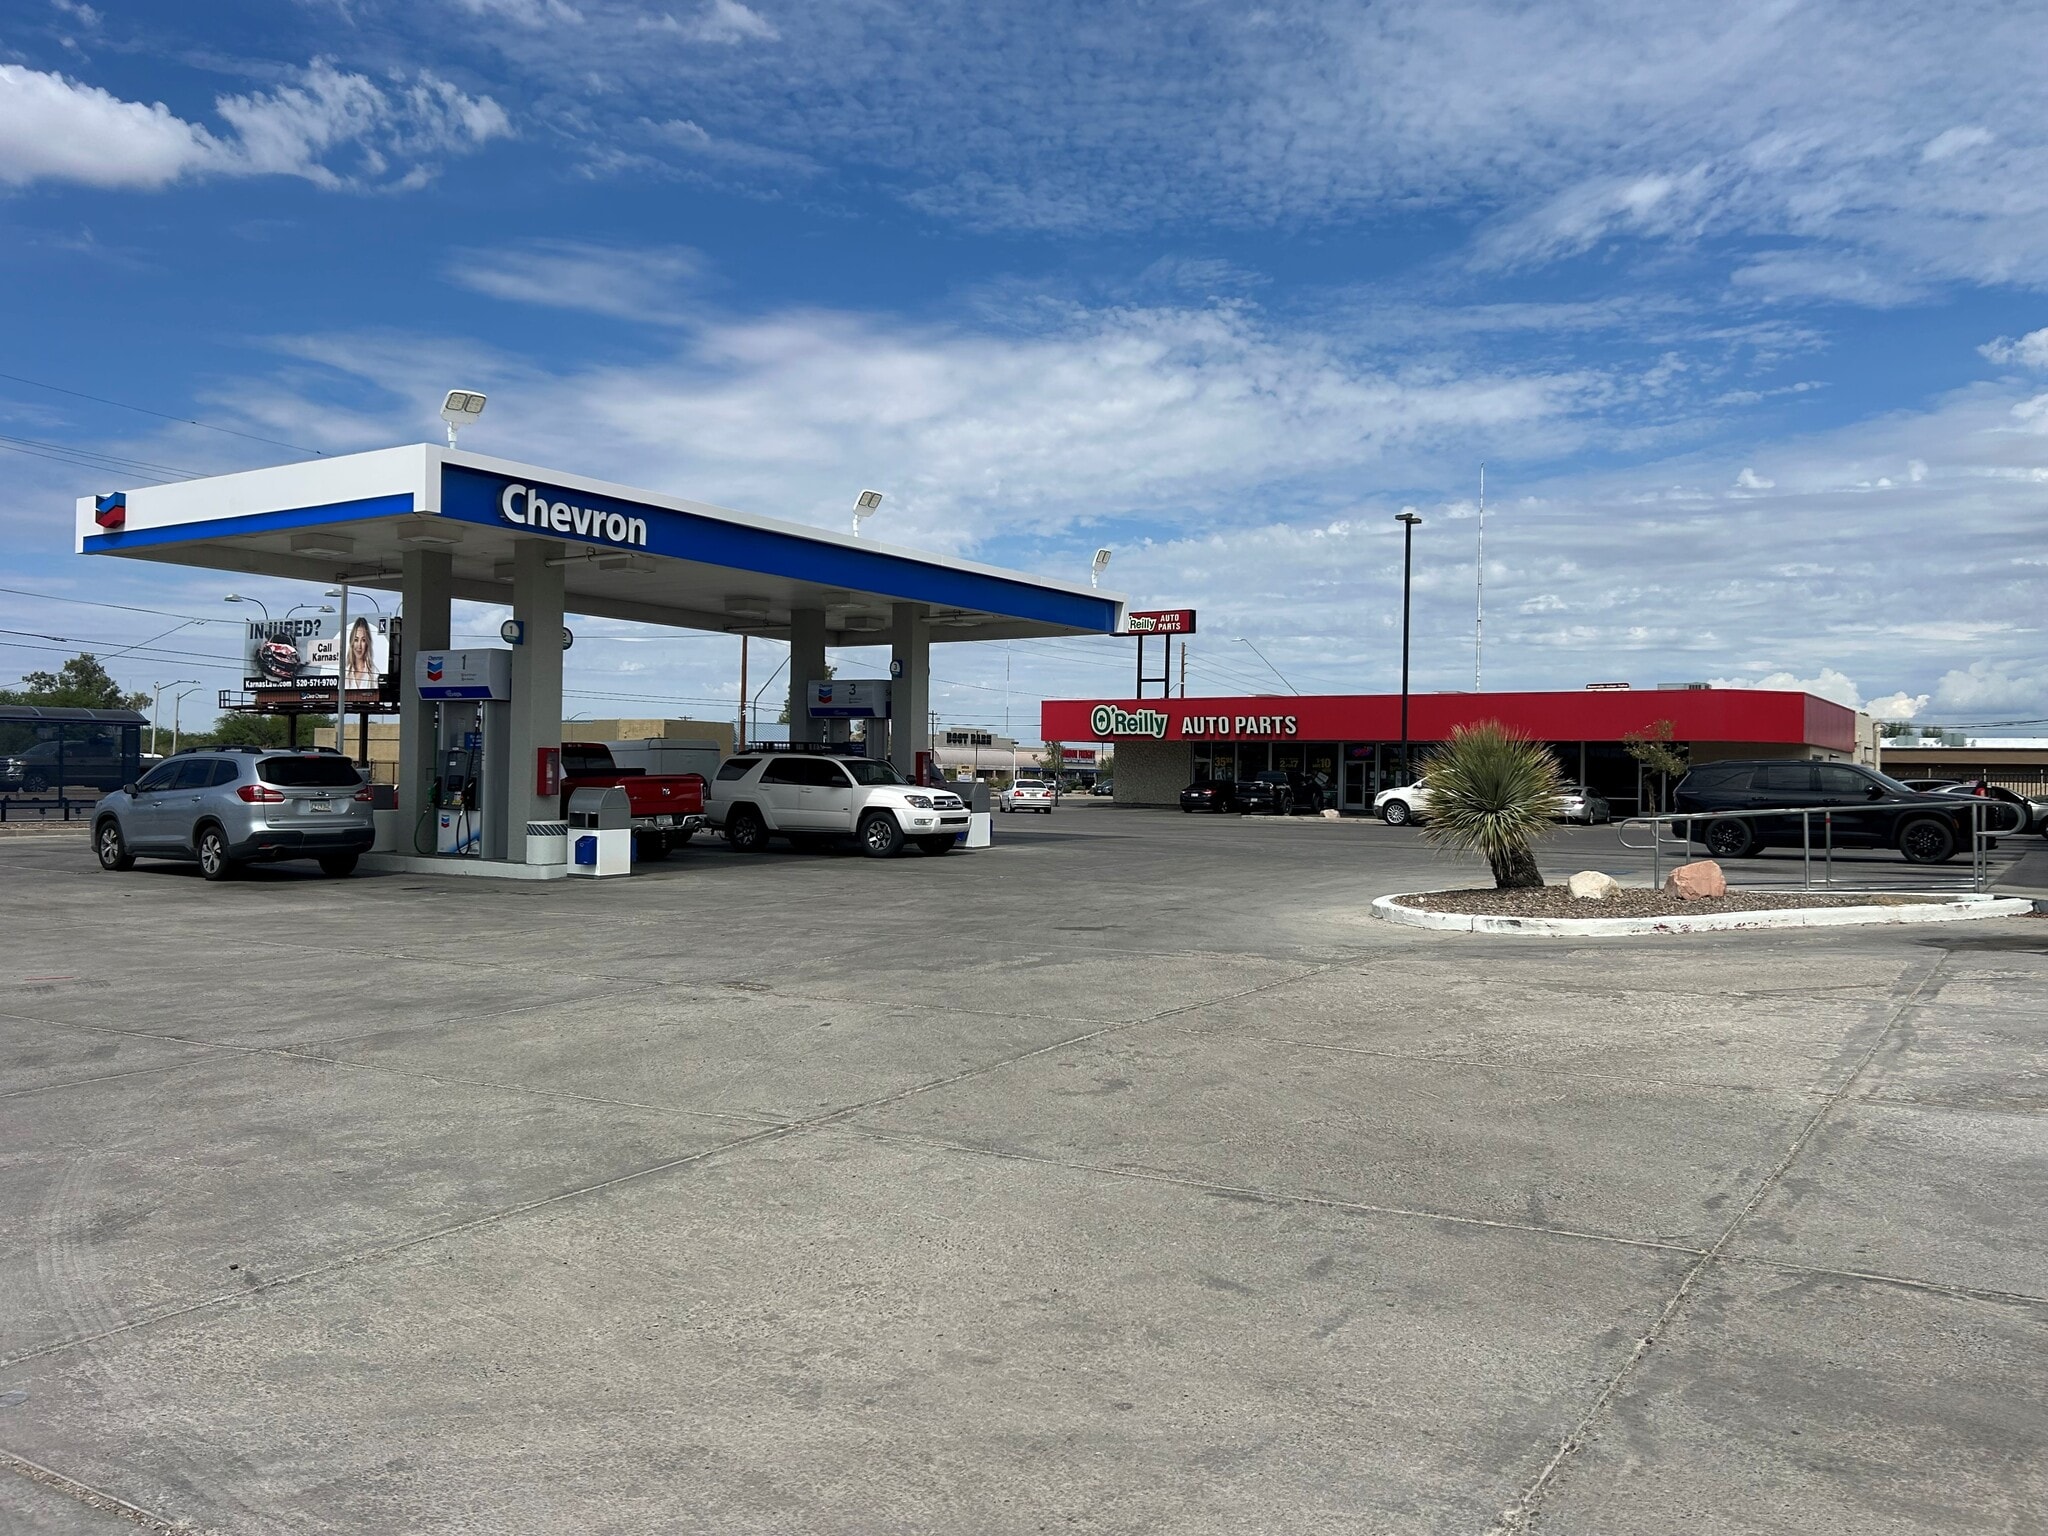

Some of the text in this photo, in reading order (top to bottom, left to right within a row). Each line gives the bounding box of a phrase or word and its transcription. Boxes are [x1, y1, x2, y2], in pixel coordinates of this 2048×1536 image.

[502, 484, 647, 546] Chevron
[1128, 617, 1156, 630] 'Reilly
[1160, 614, 1180, 622] AUTO
[250, 618, 322, 640] INJURED?
[1158, 622, 1181, 631] PARTS
[317, 643, 332, 653] Call
[312, 652, 340, 662] Karnas!
[461, 654, 467, 670] 1
[296, 678, 338, 687] 520-571-9700
[848, 683, 857, 696] 3
[1091, 705, 1167, 738] O'Reilly
[1181, 715, 1297, 735] AUTO PARTS
[946, 732, 969, 745] BOOT
